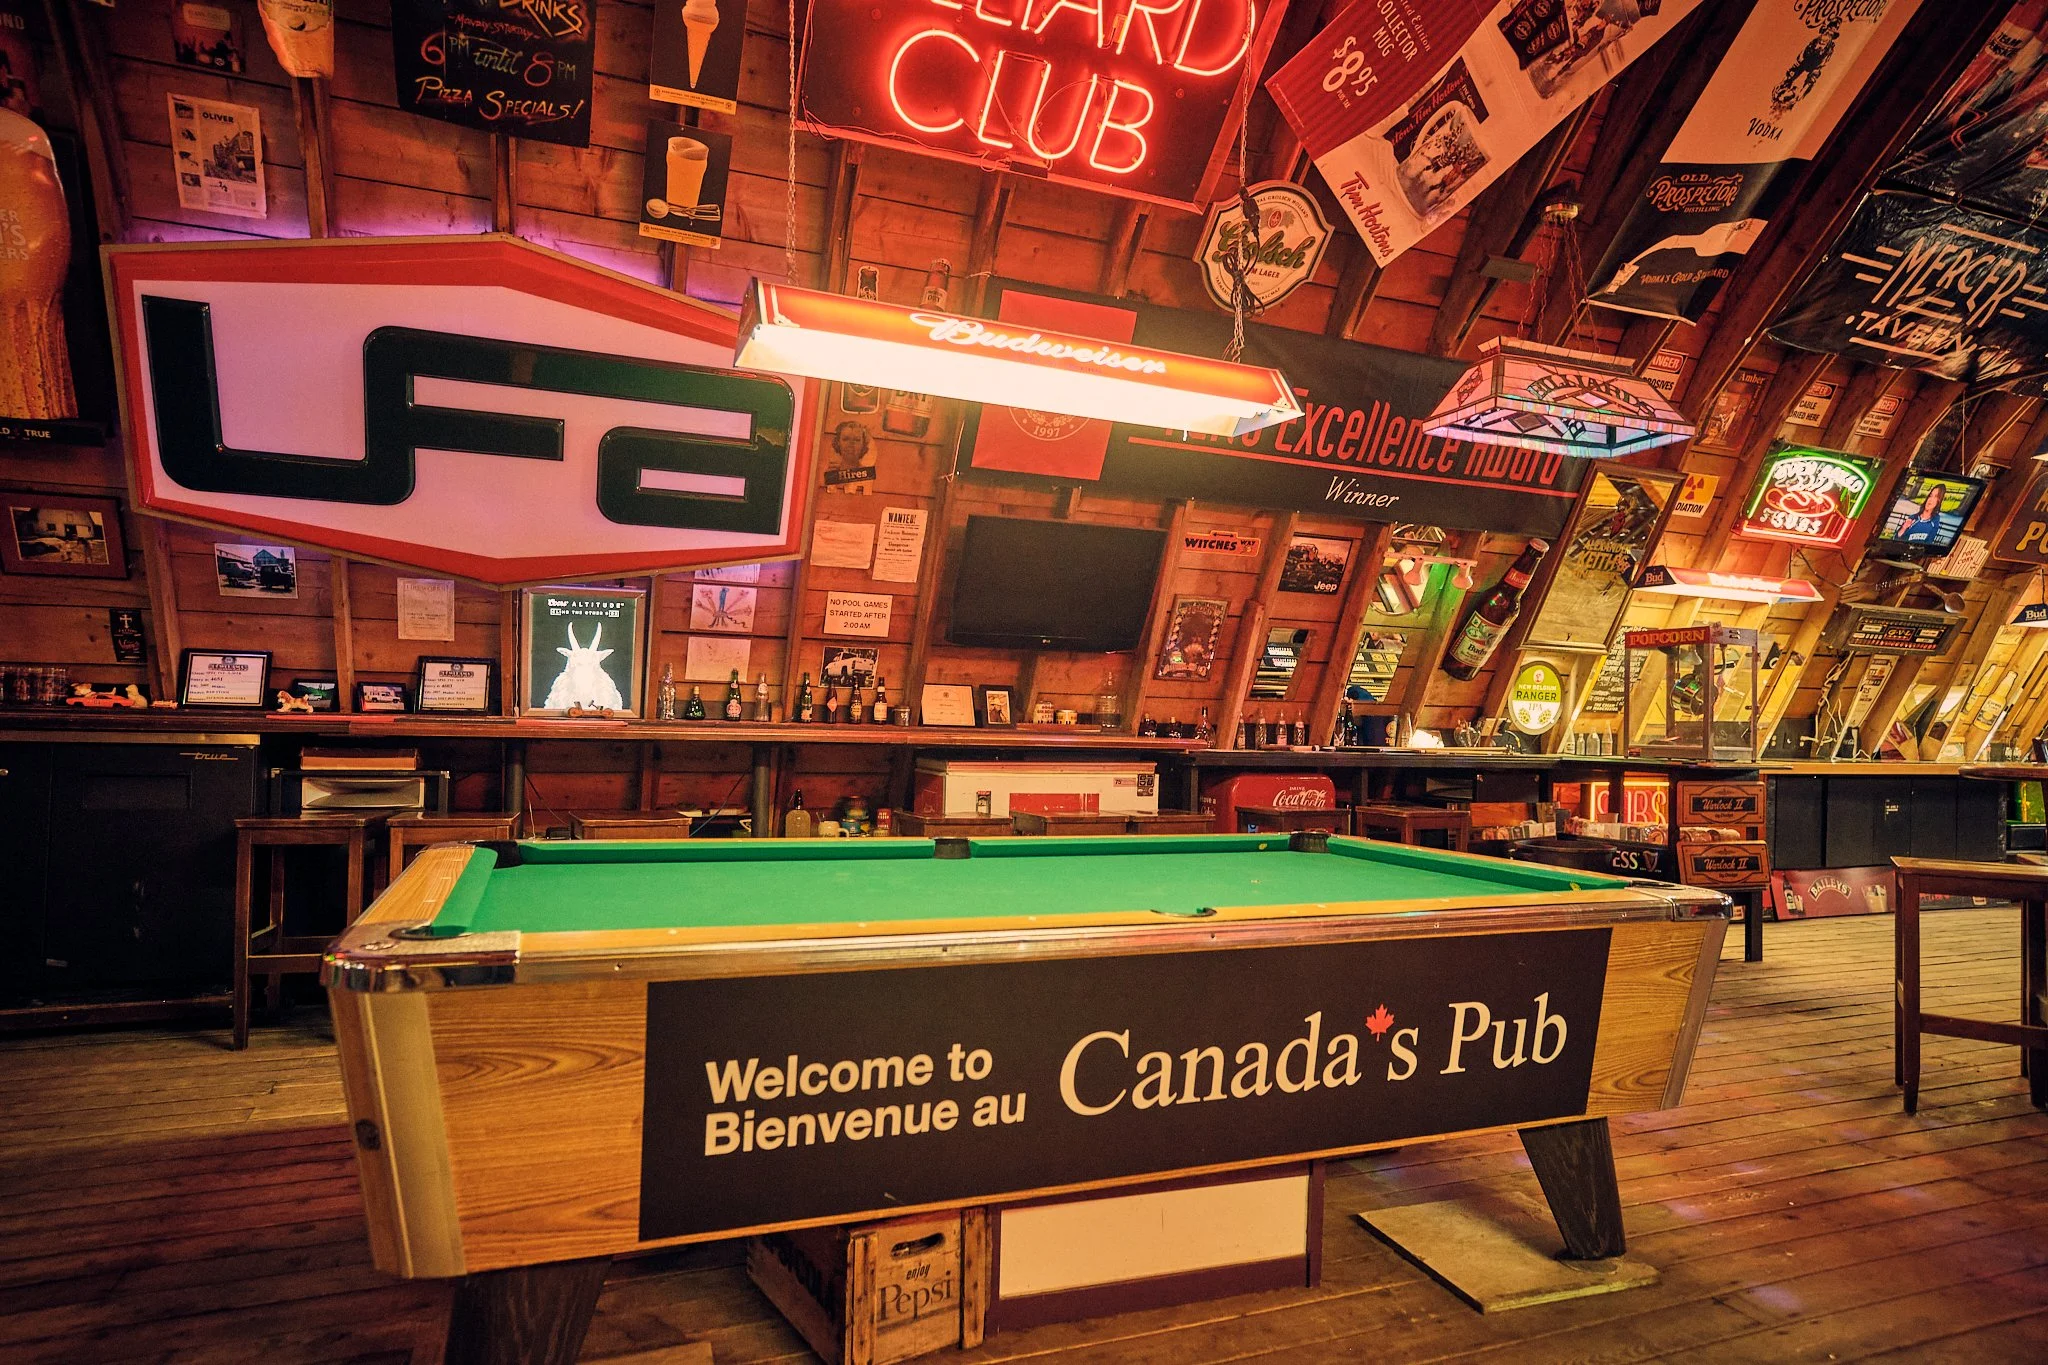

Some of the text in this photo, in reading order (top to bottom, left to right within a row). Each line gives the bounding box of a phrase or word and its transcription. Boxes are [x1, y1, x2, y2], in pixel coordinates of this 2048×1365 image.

[1376, 0, 1418, 62] COLLECTOR
[1411, 14, 1431, 52] Edition
[1372, 25, 1396, 58] MUG
[523, 52, 555, 87] 8
[556, 61, 576, 81] PM
[889, 28, 1154, 174] CLUB
[202, 111, 234, 123] OLIVER
[1745, 117, 1784, 141] VODKA
[1680, 173, 1710, 183] OLD
[1340, 170, 1395, 259] Tim Hortons
[1870, 236, 2028, 328] MERCER
[1856, 310, 1975, 353] TAVERN
[909, 313, 1167, 374] Budweiser
[1526, 373, 1656, 418] BILLIARDS
[1033, 425, 1061, 438] 1997
[838, 470, 868, 480] Hires
[1324, 475, 1400, 511] Winner
[1675, 502, 1705, 517] DIATION
[1184, 537, 1238, 551] WITCHES
[1313, 580, 1338, 592] Jeep
[1645, 572, 1664, 583] Bud
[571, 600, 621, 609] ALTITUDE
[829, 598, 889, 609] NO POOL GAMES
[829, 609, 887, 620] STARTED AFTER
[2024, 608, 2047, 620] Bud
[859, 622, 871, 630] AM
[1629, 629, 1706, 646] POPCORN
[1516, 690, 1557, 701] RANGER
[1702, 798, 1733, 811] Warlock
[1704, 858, 1736, 871] Warlock
[1809, 876, 1850, 899] BAILEYS
[1439, 992, 1569, 1076] Pub
[704, 1043, 993, 1105] Welcome to
[704, 1092, 1027, 1157] Bienvenue au
[906, 1261, 931, 1281] enjoy
[878, 1269, 953, 1322] Pepsi
